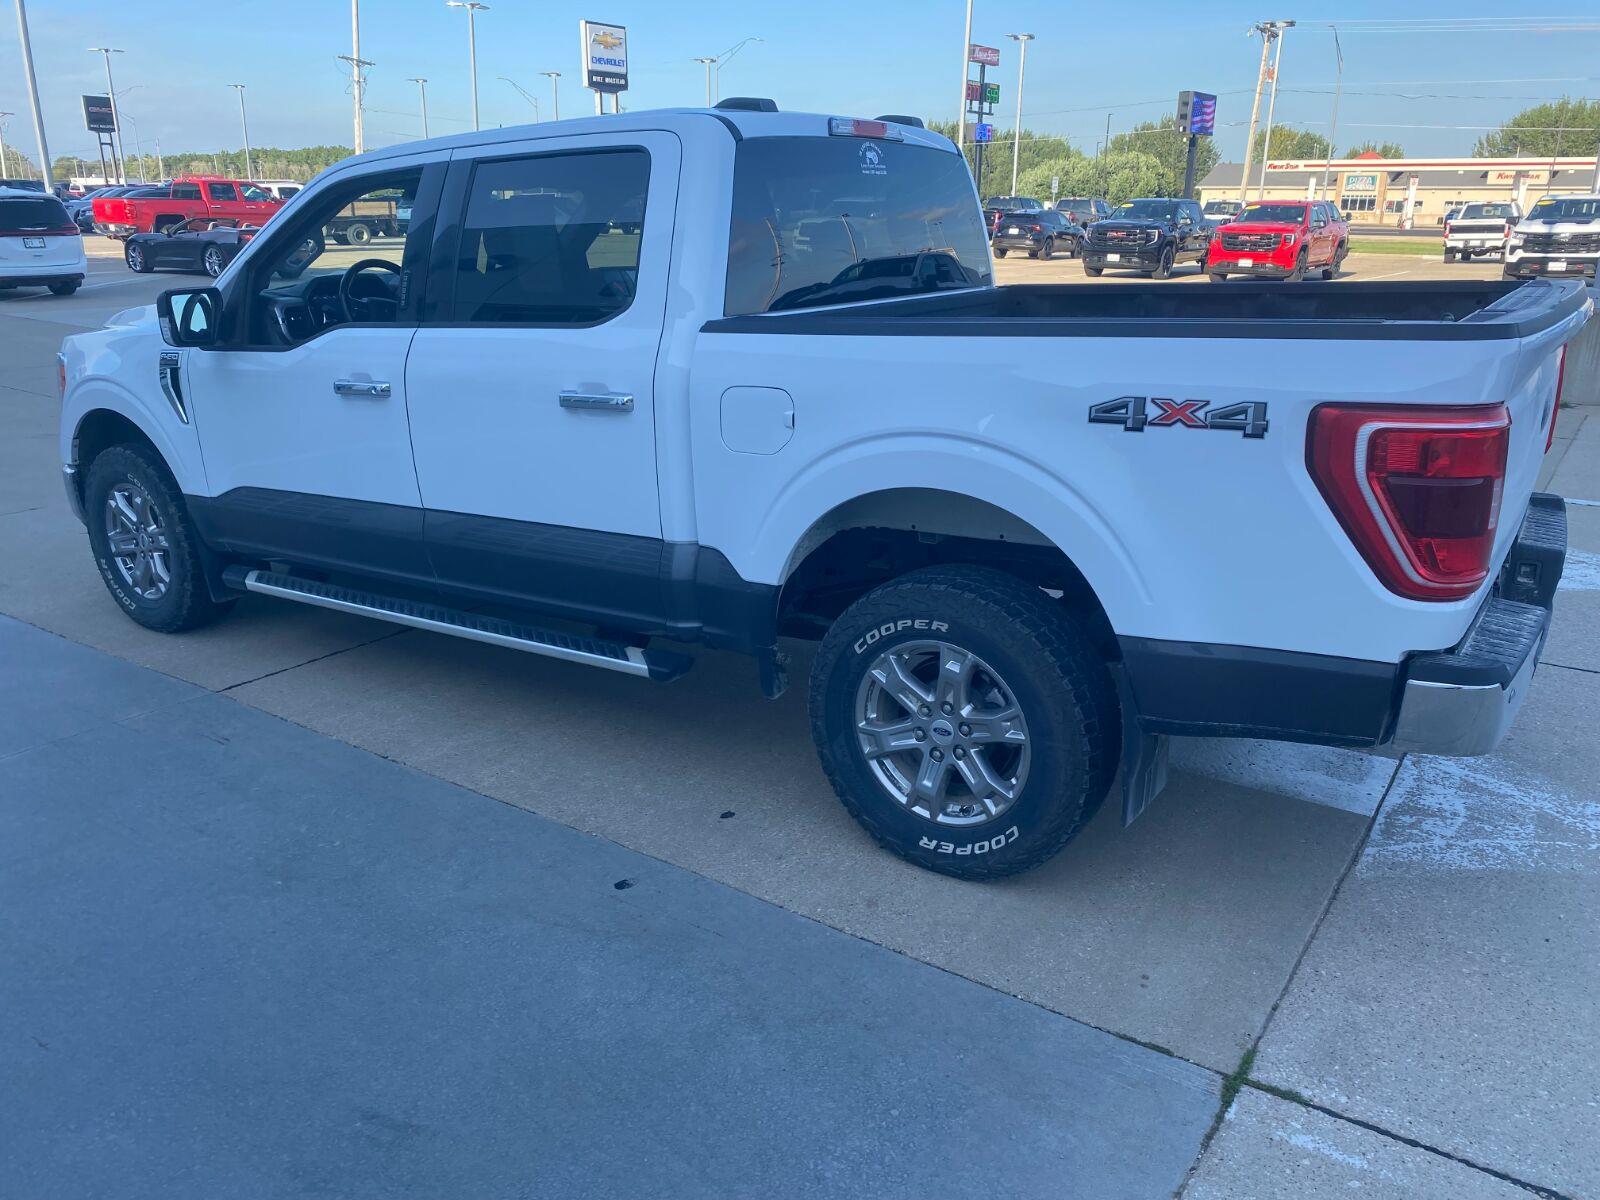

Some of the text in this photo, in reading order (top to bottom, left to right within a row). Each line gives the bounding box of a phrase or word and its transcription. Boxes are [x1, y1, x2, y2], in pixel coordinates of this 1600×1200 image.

[592, 56, 625, 67] CHEVROLET
[1348, 175, 1374, 185] PIZZA
[853, 619, 950, 655] COOPER
[918, 825, 1020, 856] COOPER
